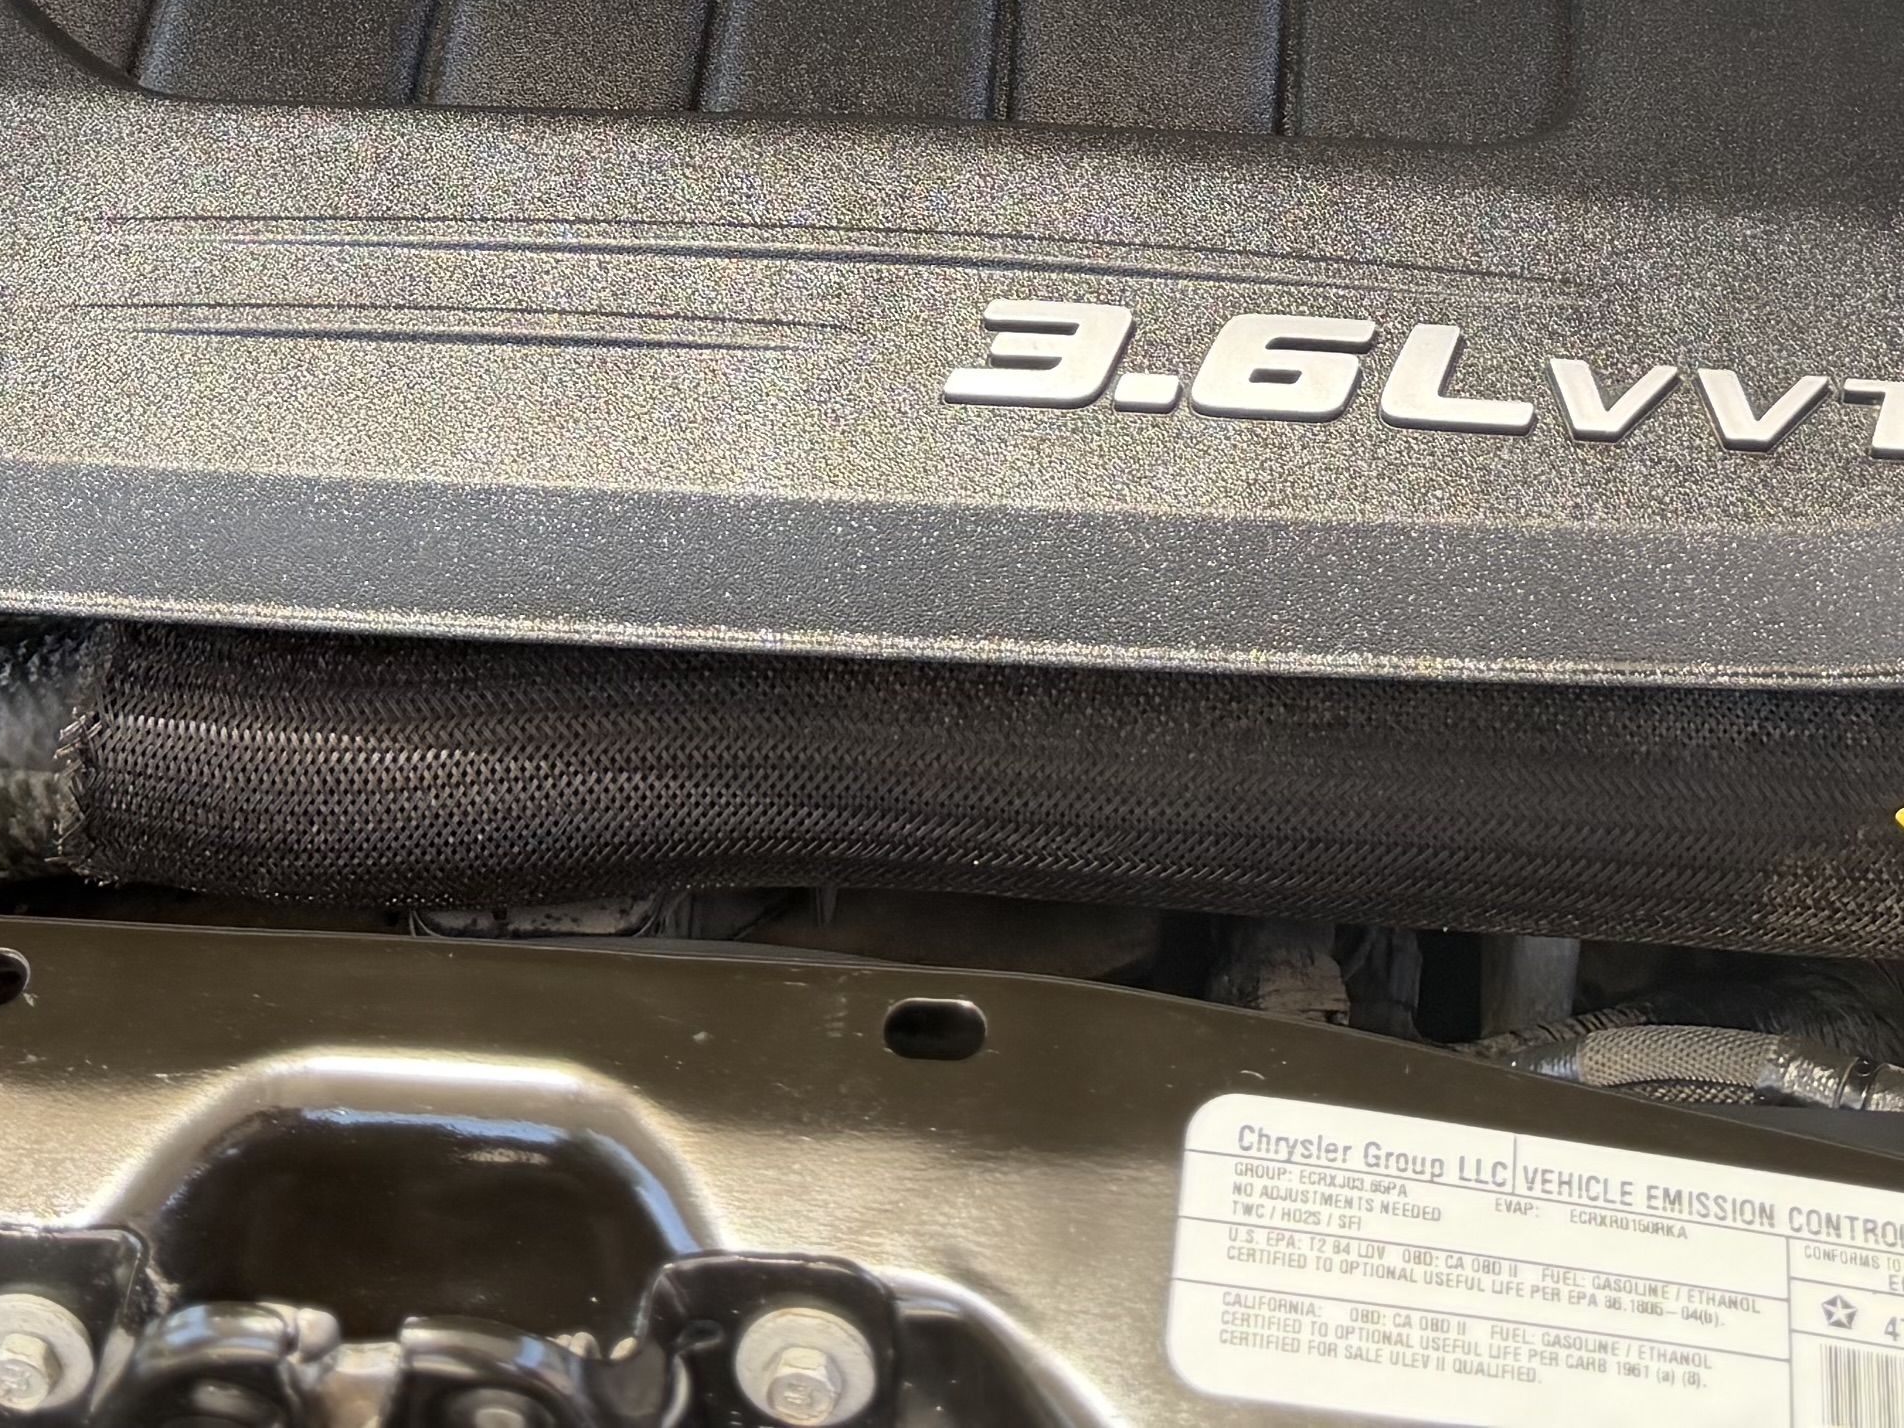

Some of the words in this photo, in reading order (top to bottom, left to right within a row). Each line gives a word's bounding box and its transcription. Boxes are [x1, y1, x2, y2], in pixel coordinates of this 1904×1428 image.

[942, 297, 1538, 438] 3.6L
[1232, 1180, 1255, 1199] NO
[1260, 1184, 1375, 1213] ADJUSTMENTS
[1380, 1200, 1441, 1222] NEEDED
[1234, 1162, 1293, 1183] GROUP:
[1238, 1124, 1352, 1164] Chrysler
[1363, 1141, 1444, 1181] Group
[1458, 1156, 1508, 1187] LLC
[1522, 1165, 1633, 1206] VEHICLE
[1647, 1185, 1775, 1228] EMISSION
[1232, 1200, 1265, 1220] TWC
[1338, 1214, 1362, 1231] SFI
[1495, 1198, 1540, 1218] EVAP:
[1225, 1245, 1307, 1269] CERTIFIED
[1315, 1256, 1333, 1273] TO
[1339, 1258, 1417, 1284] OPTIONAL
[1423, 1268, 1486, 1292] USEFUL
[1491, 1280, 1524, 1298] LIFE
[1530, 1284, 1561, 1302] PER
[1568, 1290, 1598, 1307] EPA
[1228, 1227, 1259, 1245] U.S.
[1266, 1232, 1302, 1250] EPA:
[1309, 1236, 1327, 1252] T2
[1357, 1242, 1385, 1259] LDV
[1402, 1248, 1439, 1267] OBD:
[1444, 1254, 1465, 1271] CA
[1471, 1256, 1502, 1276] OBD
[1541, 1267, 1586, 1288] FUEL:
[1592, 1275, 1670, 1300] GASOLINE
[1687, 1288, 1761, 1314] ETHANOL
[1804, 1245, 1879, 1269] CONFORMS
[1886, 1257, 1901, 1273] TO
[1219, 1328, 1300, 1354] CERTIFIED
[1307, 1339, 1337, 1359] FOR
[1344, 1343, 1383, 1364] SALE
[1389, 1349, 1429, 1370] ULEV
[1452, 1356, 1542, 1384] QUALIFIED.
[1221, 1310, 1302, 1334] CERTIFIED
[1310, 1320, 1328, 1338] TO
[1335, 1323, 1414, 1349] OPTIONAL
[1420, 1333, 1482, 1358] USEFUL
[1489, 1342, 1522, 1362] LIFE
[1528, 1347, 1559, 1367] PER
[1565, 1353, 1607, 1374] CARB
[1616, 1360, 1650, 1379] 1961
[1656, 1366, 1676, 1386] (a)
[1222, 1291, 1322, 1318] CALIFORNIA:
[1349, 1307, 1387, 1327] OBD:
[1393, 1312, 1413, 1331] CA
[1419, 1315, 1451, 1334] OBD
[1490, 1324, 1536, 1346] FUEL:
[1541, 1331, 1620, 1357] GASOLINE
[1638, 1345, 1713, 1370] ETHANOL
